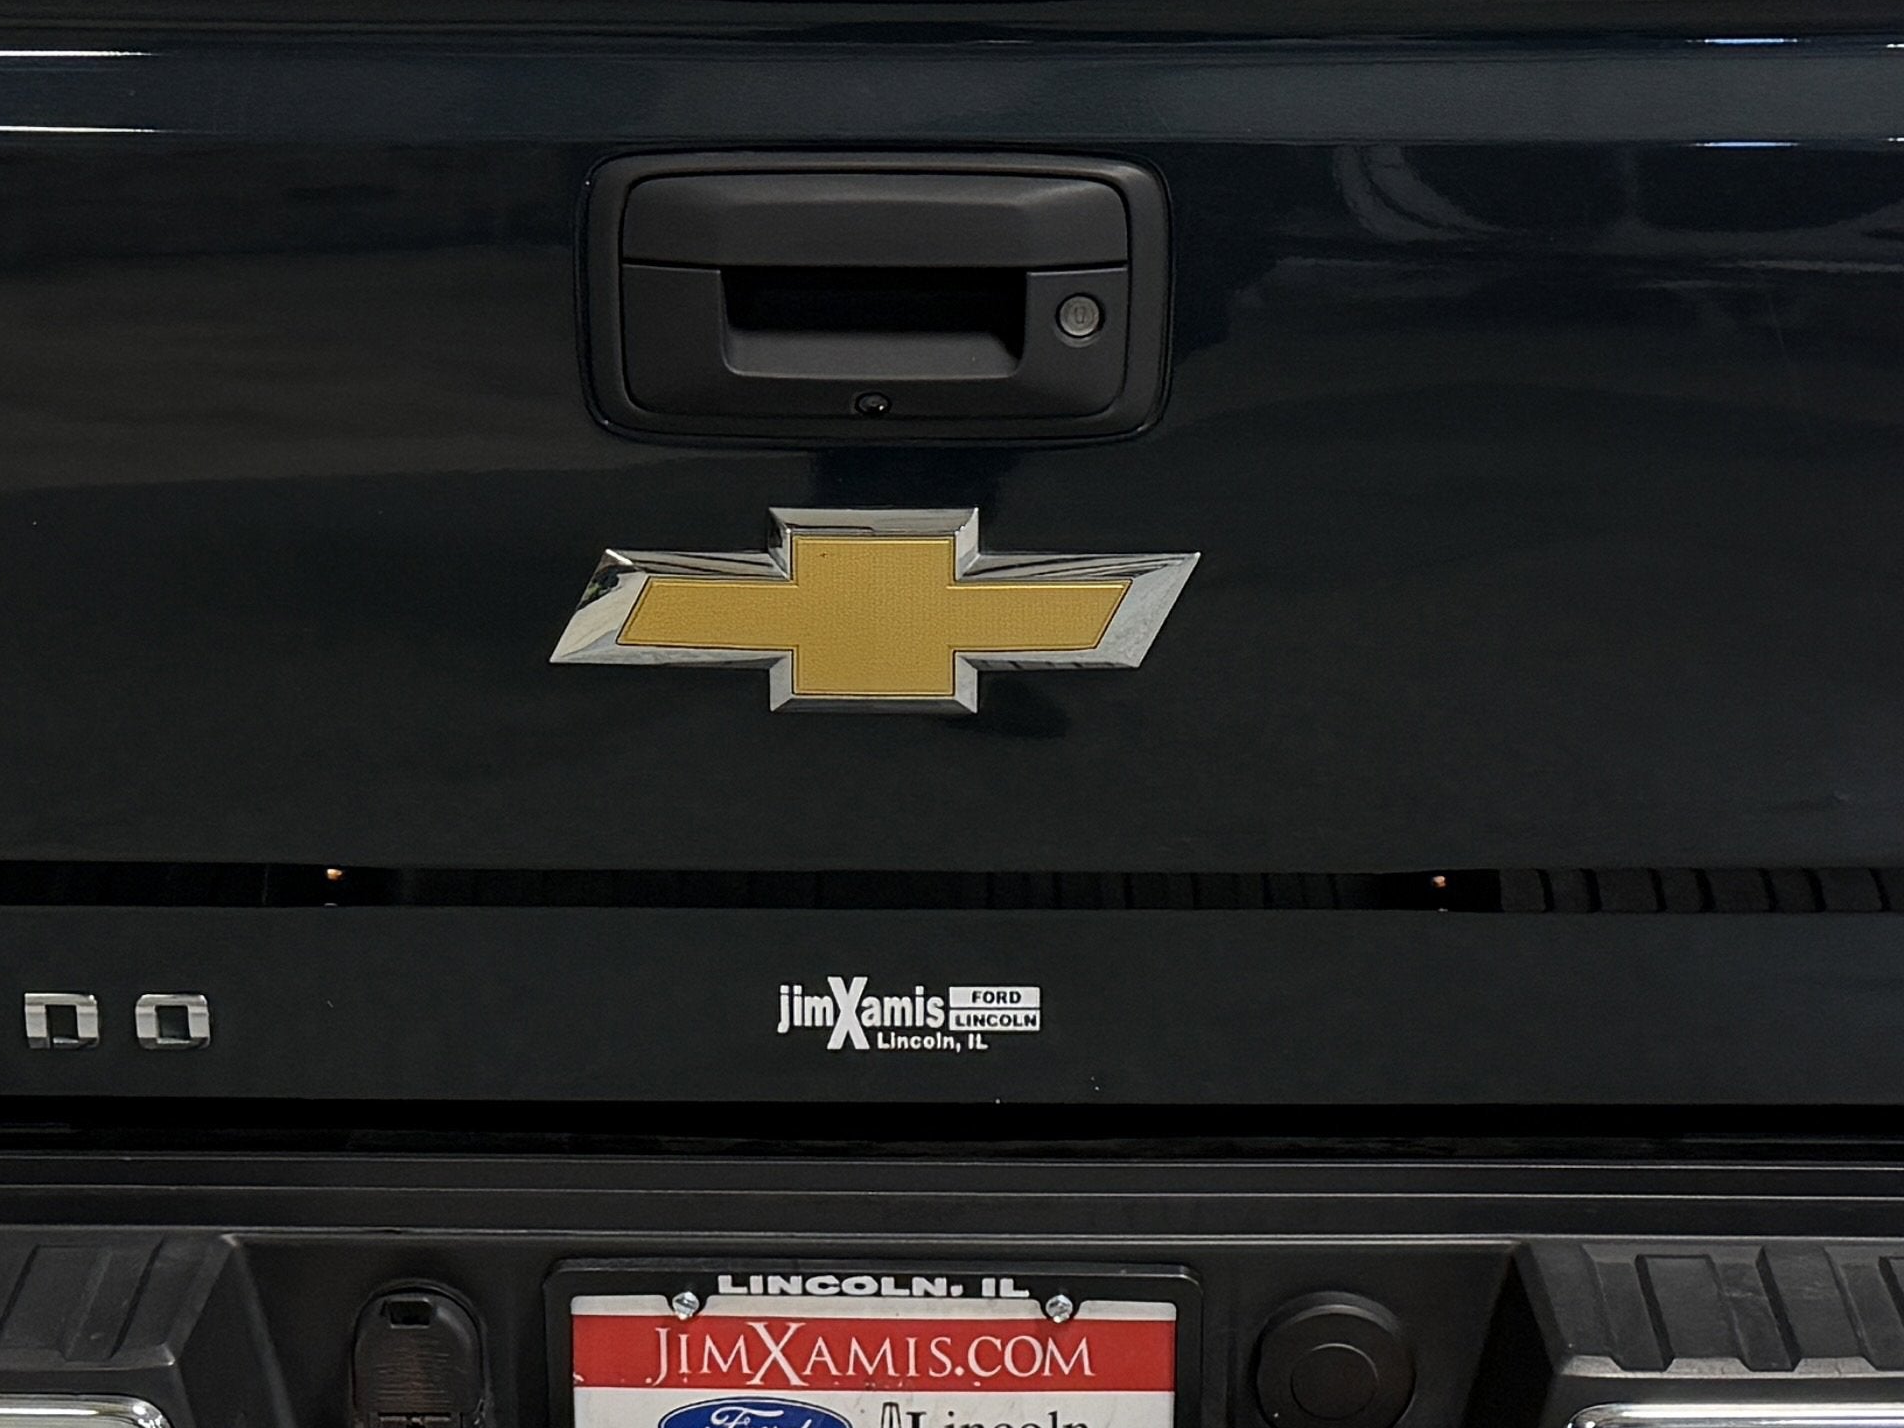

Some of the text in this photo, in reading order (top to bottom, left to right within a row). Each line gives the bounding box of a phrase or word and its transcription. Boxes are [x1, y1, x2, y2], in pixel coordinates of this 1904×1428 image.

[971, 990, 1022, 1005] FORD
[955, 1013, 1037, 1028] LINCOLN
[877, 1032, 989, 1054] Lincoln, IL
[981, 1277, 1031, 1299] IL
[653, 1322, 1096, 1386] JIMXAMIS.COM
